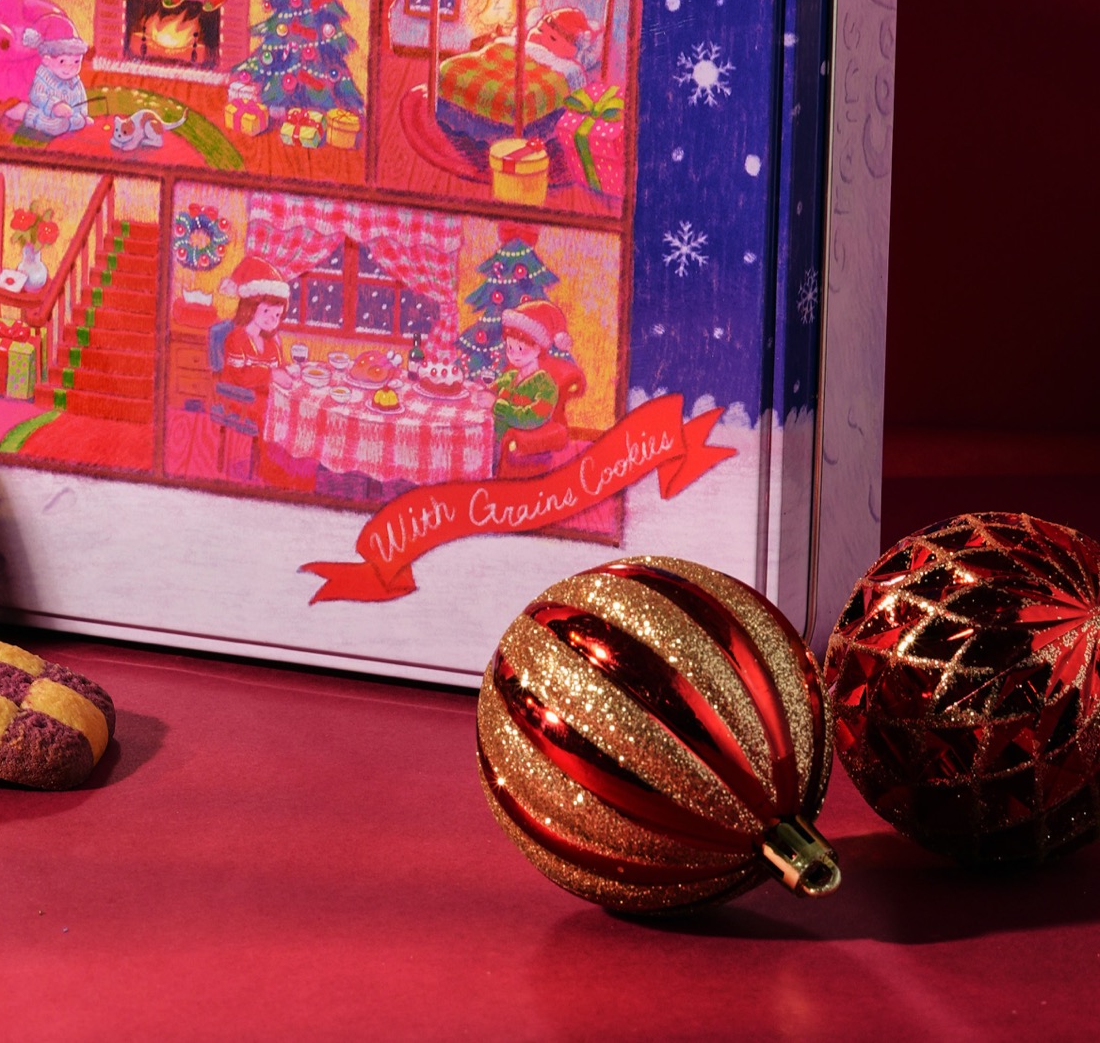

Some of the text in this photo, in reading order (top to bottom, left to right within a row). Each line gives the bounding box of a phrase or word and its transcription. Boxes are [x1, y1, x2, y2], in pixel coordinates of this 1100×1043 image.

[369, 430, 675, 563] With Grains Cookies
